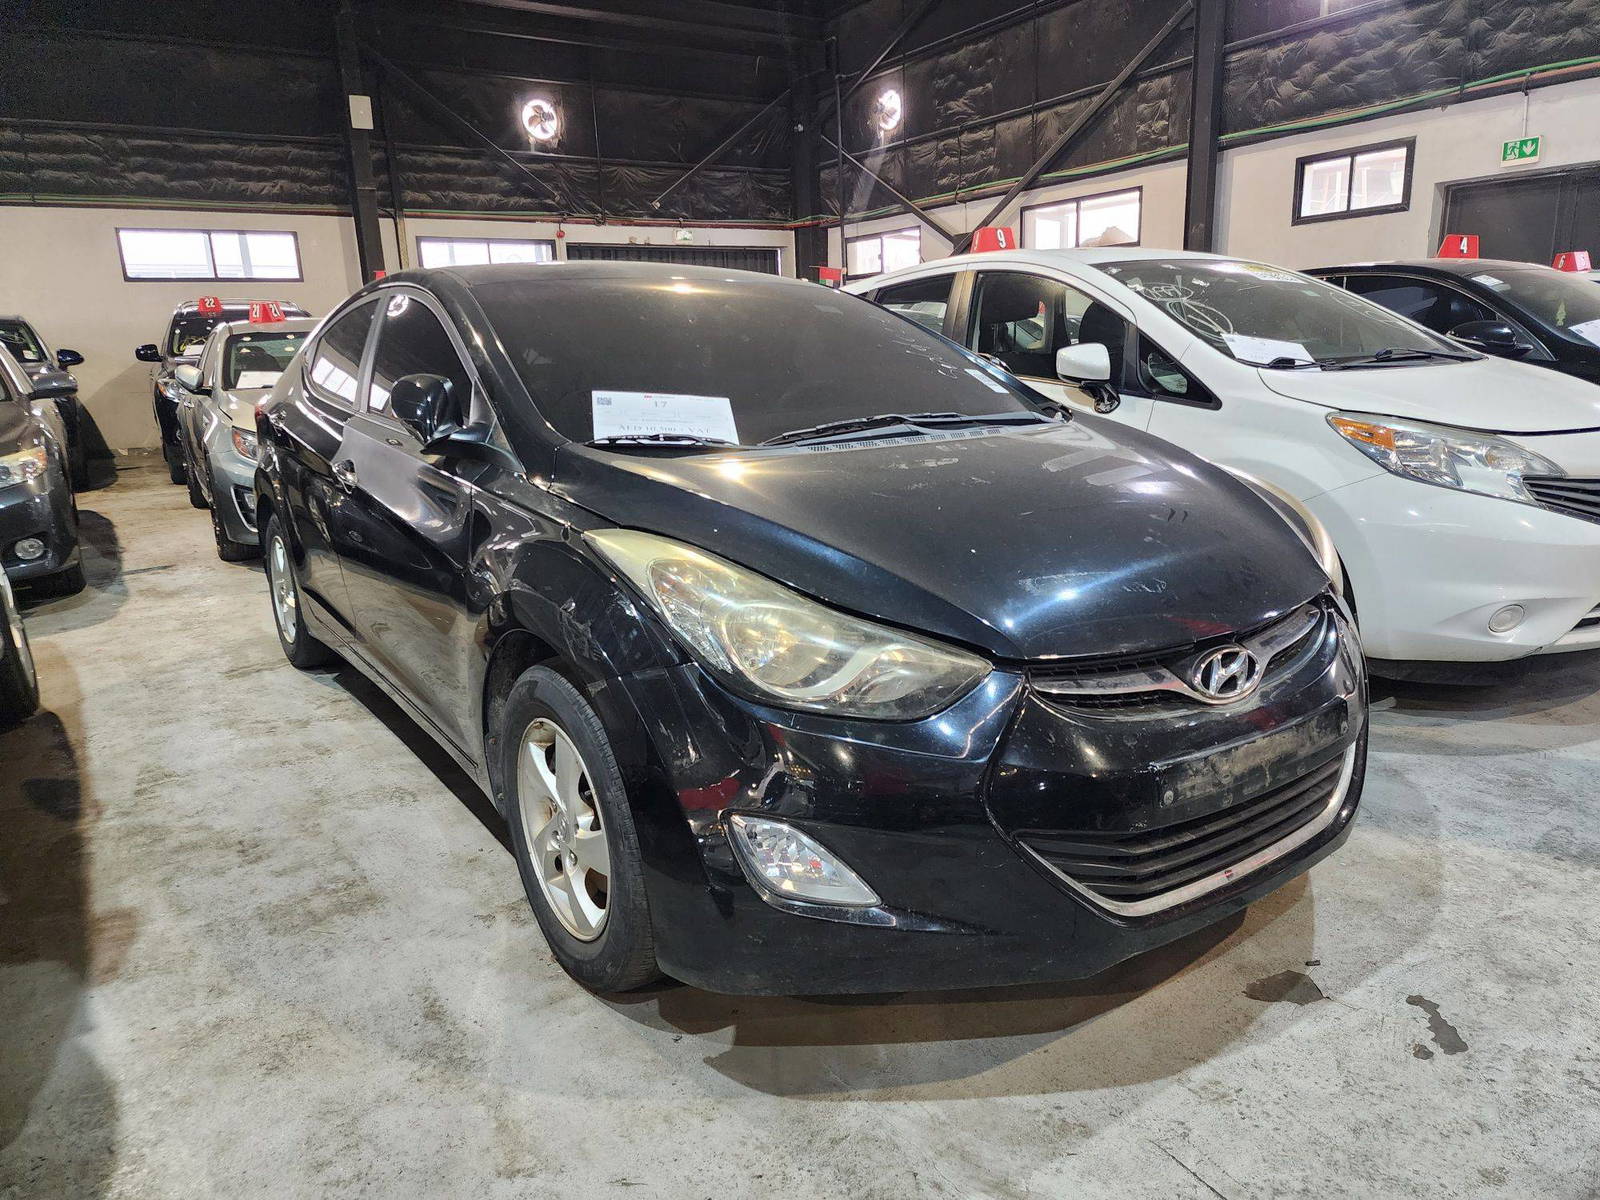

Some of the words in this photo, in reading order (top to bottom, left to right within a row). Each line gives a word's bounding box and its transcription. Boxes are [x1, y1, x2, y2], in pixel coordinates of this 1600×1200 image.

[997, 228, 1007, 249] 9
[1460, 236, 1468, 254] 4
[1558, 254, 1566, 269] 6
[204, 298, 216, 308] 22
[252, 303, 260, 318] 21
[268, 303, 281, 318] 21
